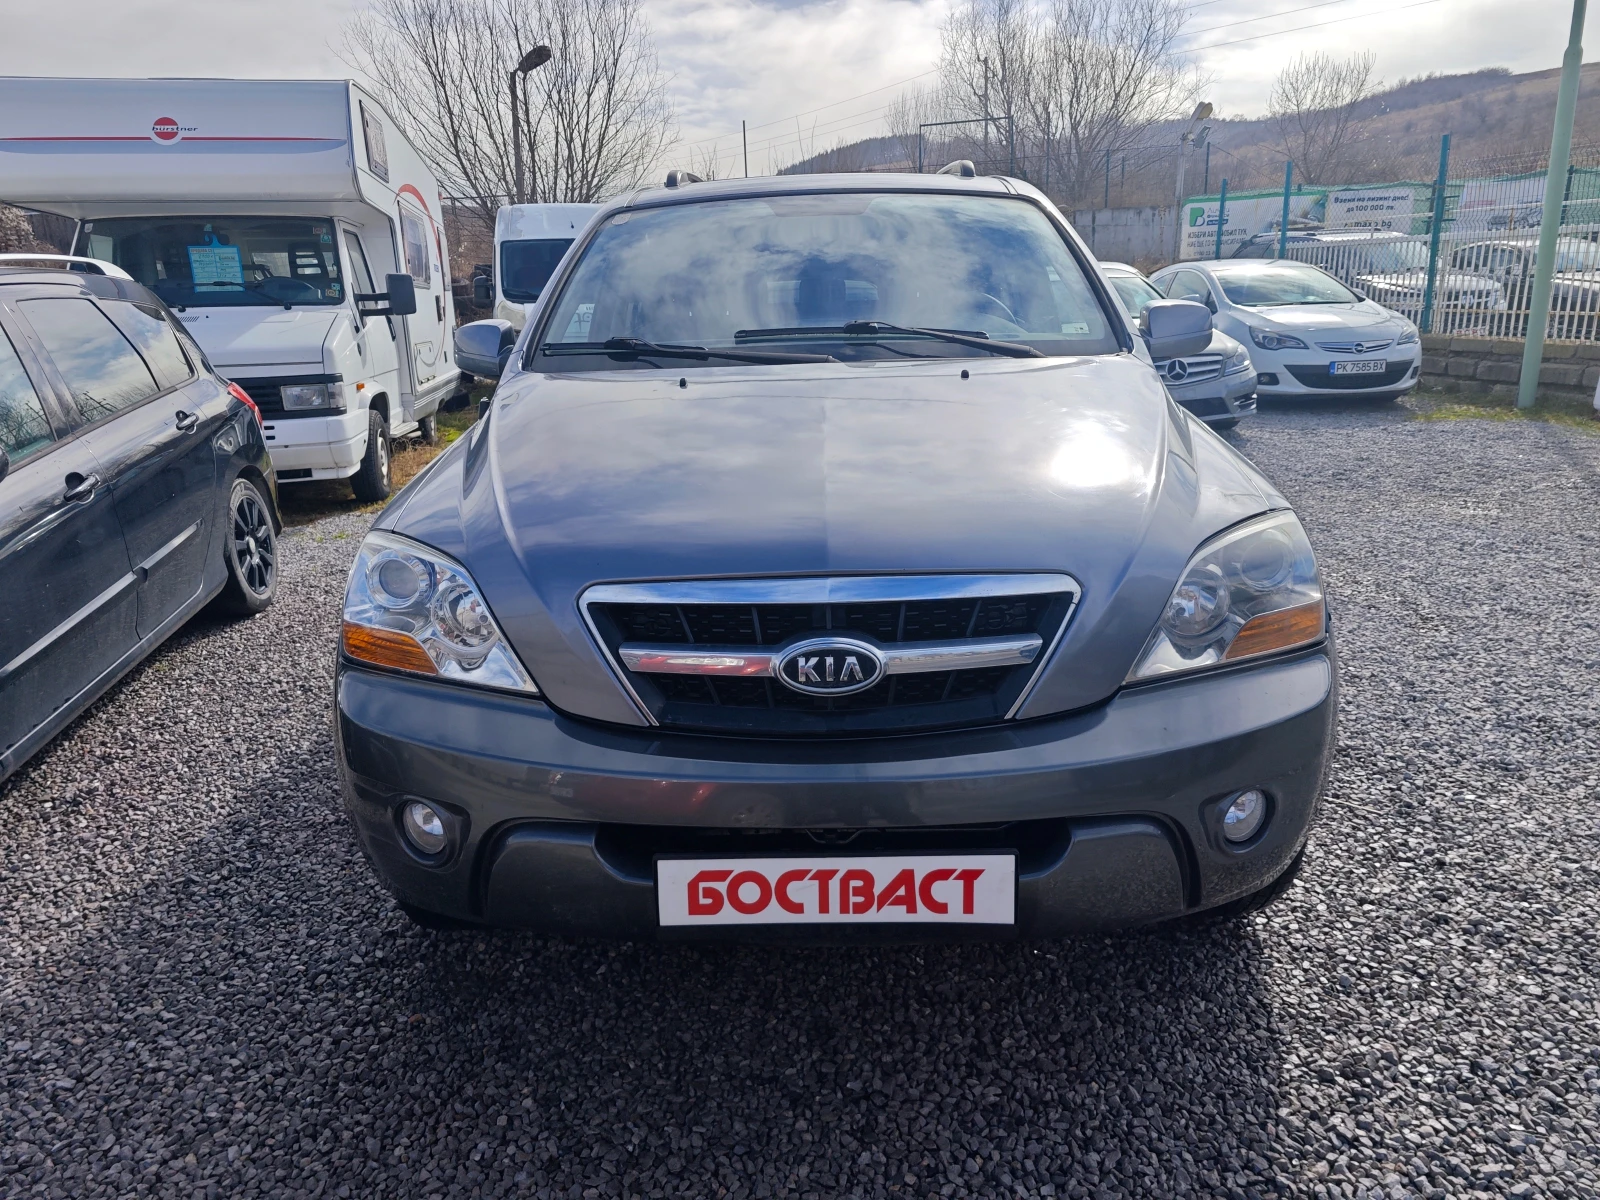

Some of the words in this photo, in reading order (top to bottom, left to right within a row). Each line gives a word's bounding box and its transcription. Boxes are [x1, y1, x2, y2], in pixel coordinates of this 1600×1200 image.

[1187, 230, 1206, 239] ИЗБЕРИ
[1336, 363, 1349, 372] PK
[1350, 362, 1372, 372] 7585
[1372, 361, 1384, 371] BX
[796, 656, 865, 682] KIA
[687, 868, 986, 916] БОСТВАСТ
